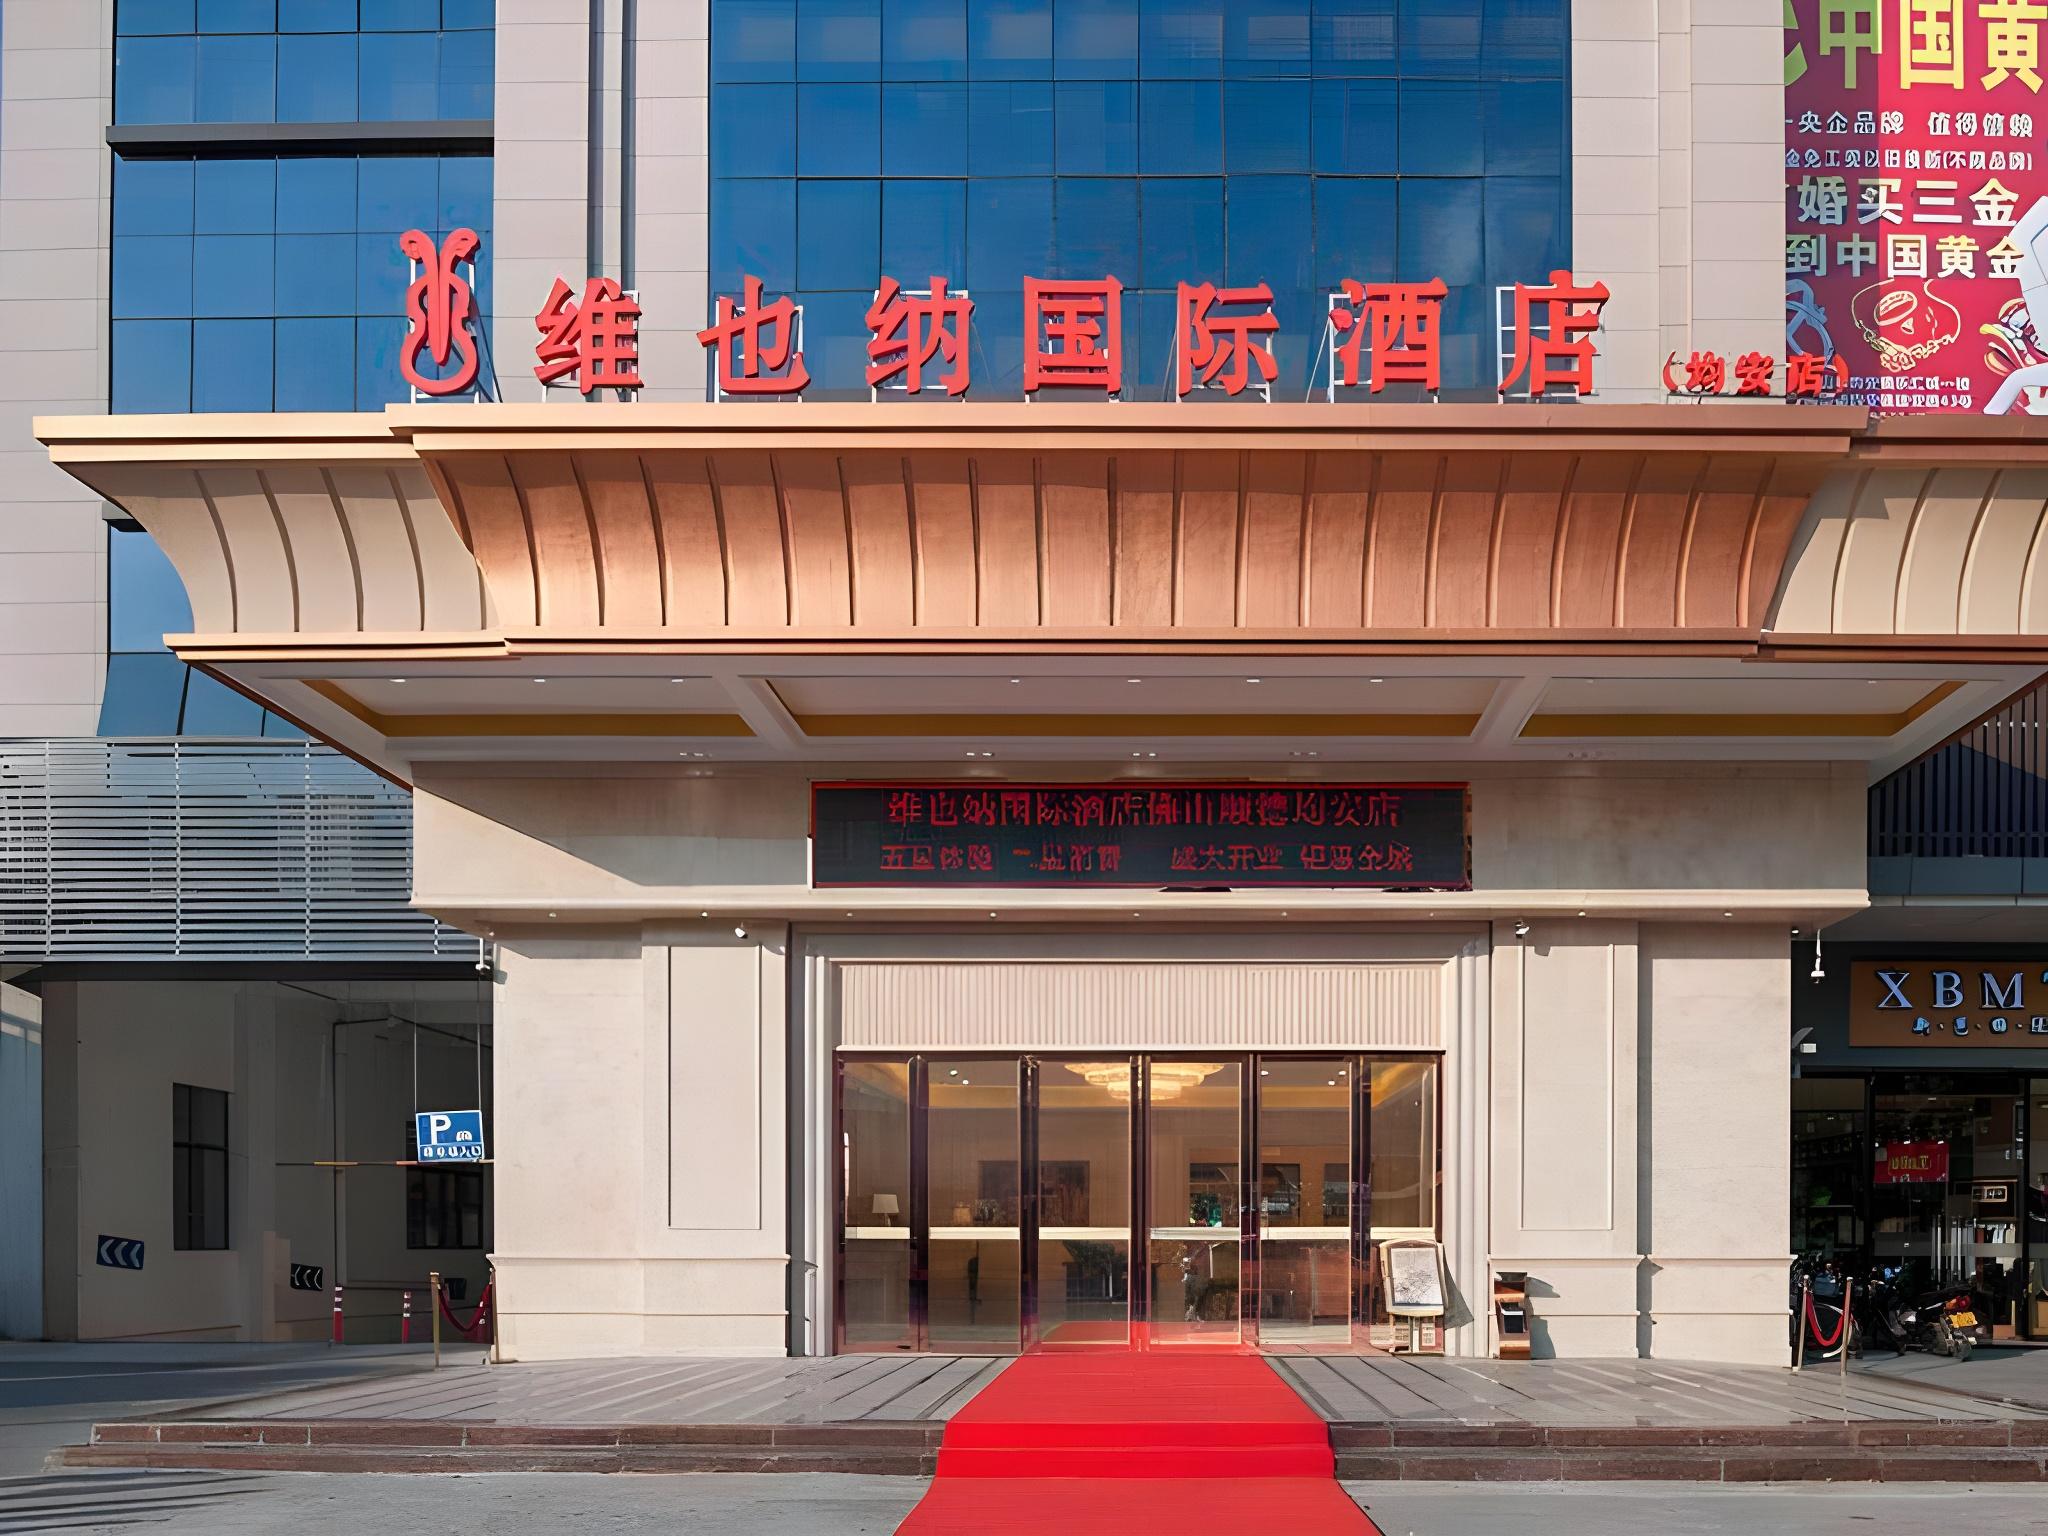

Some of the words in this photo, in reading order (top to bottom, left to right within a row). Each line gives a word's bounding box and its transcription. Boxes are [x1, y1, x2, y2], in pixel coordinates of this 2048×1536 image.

[1785, 175, 2020, 227] 婚买三金
[1785, 233, 2025, 279] 到中国黄金
[534, 269, 1611, 398] 维也纳国际酒店
[1877, 970, 2048, 1009] XBM
[430, 1114, 452, 1146] P
